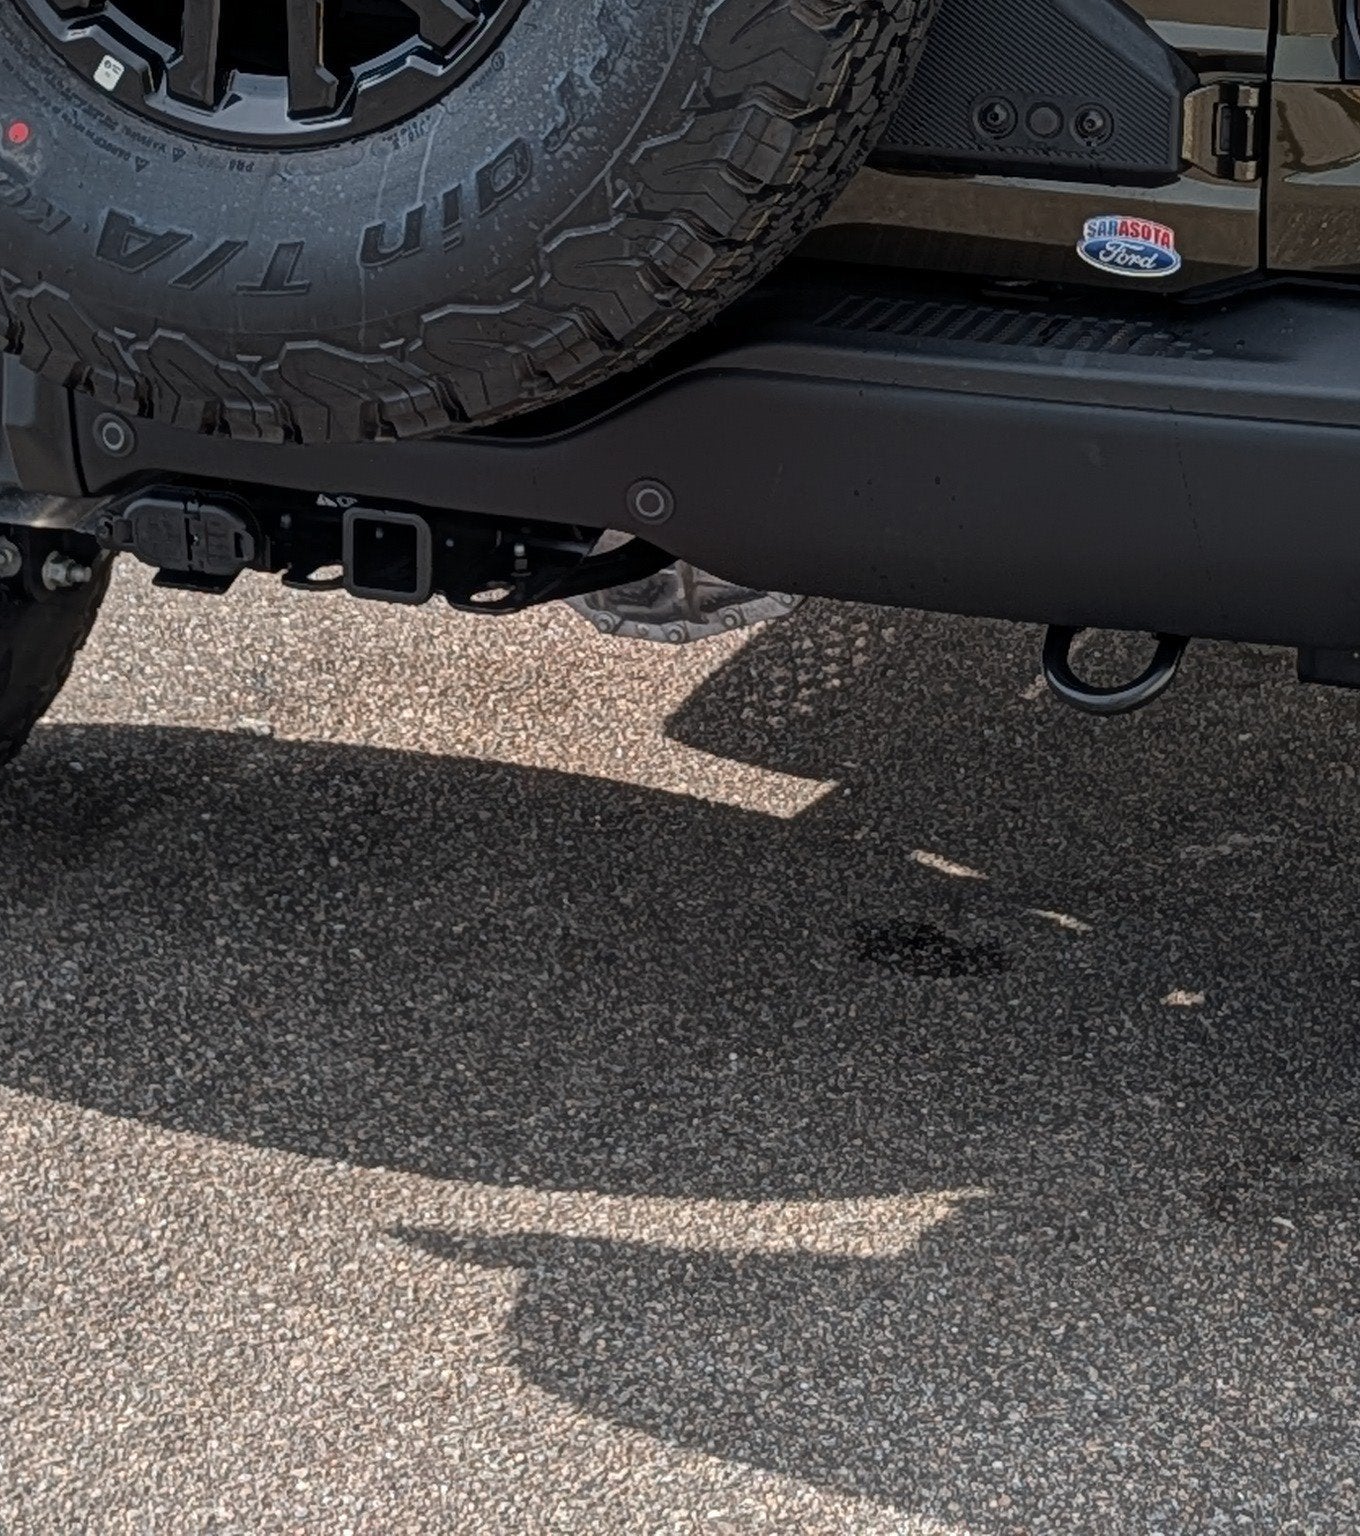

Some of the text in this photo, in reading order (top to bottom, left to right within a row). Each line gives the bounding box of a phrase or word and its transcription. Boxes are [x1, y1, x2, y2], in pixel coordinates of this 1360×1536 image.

[1086, 219, 1172, 248] SARASOTA
[95, 207, 313, 295] T/A
[1098, 240, 1159, 270] Ford
